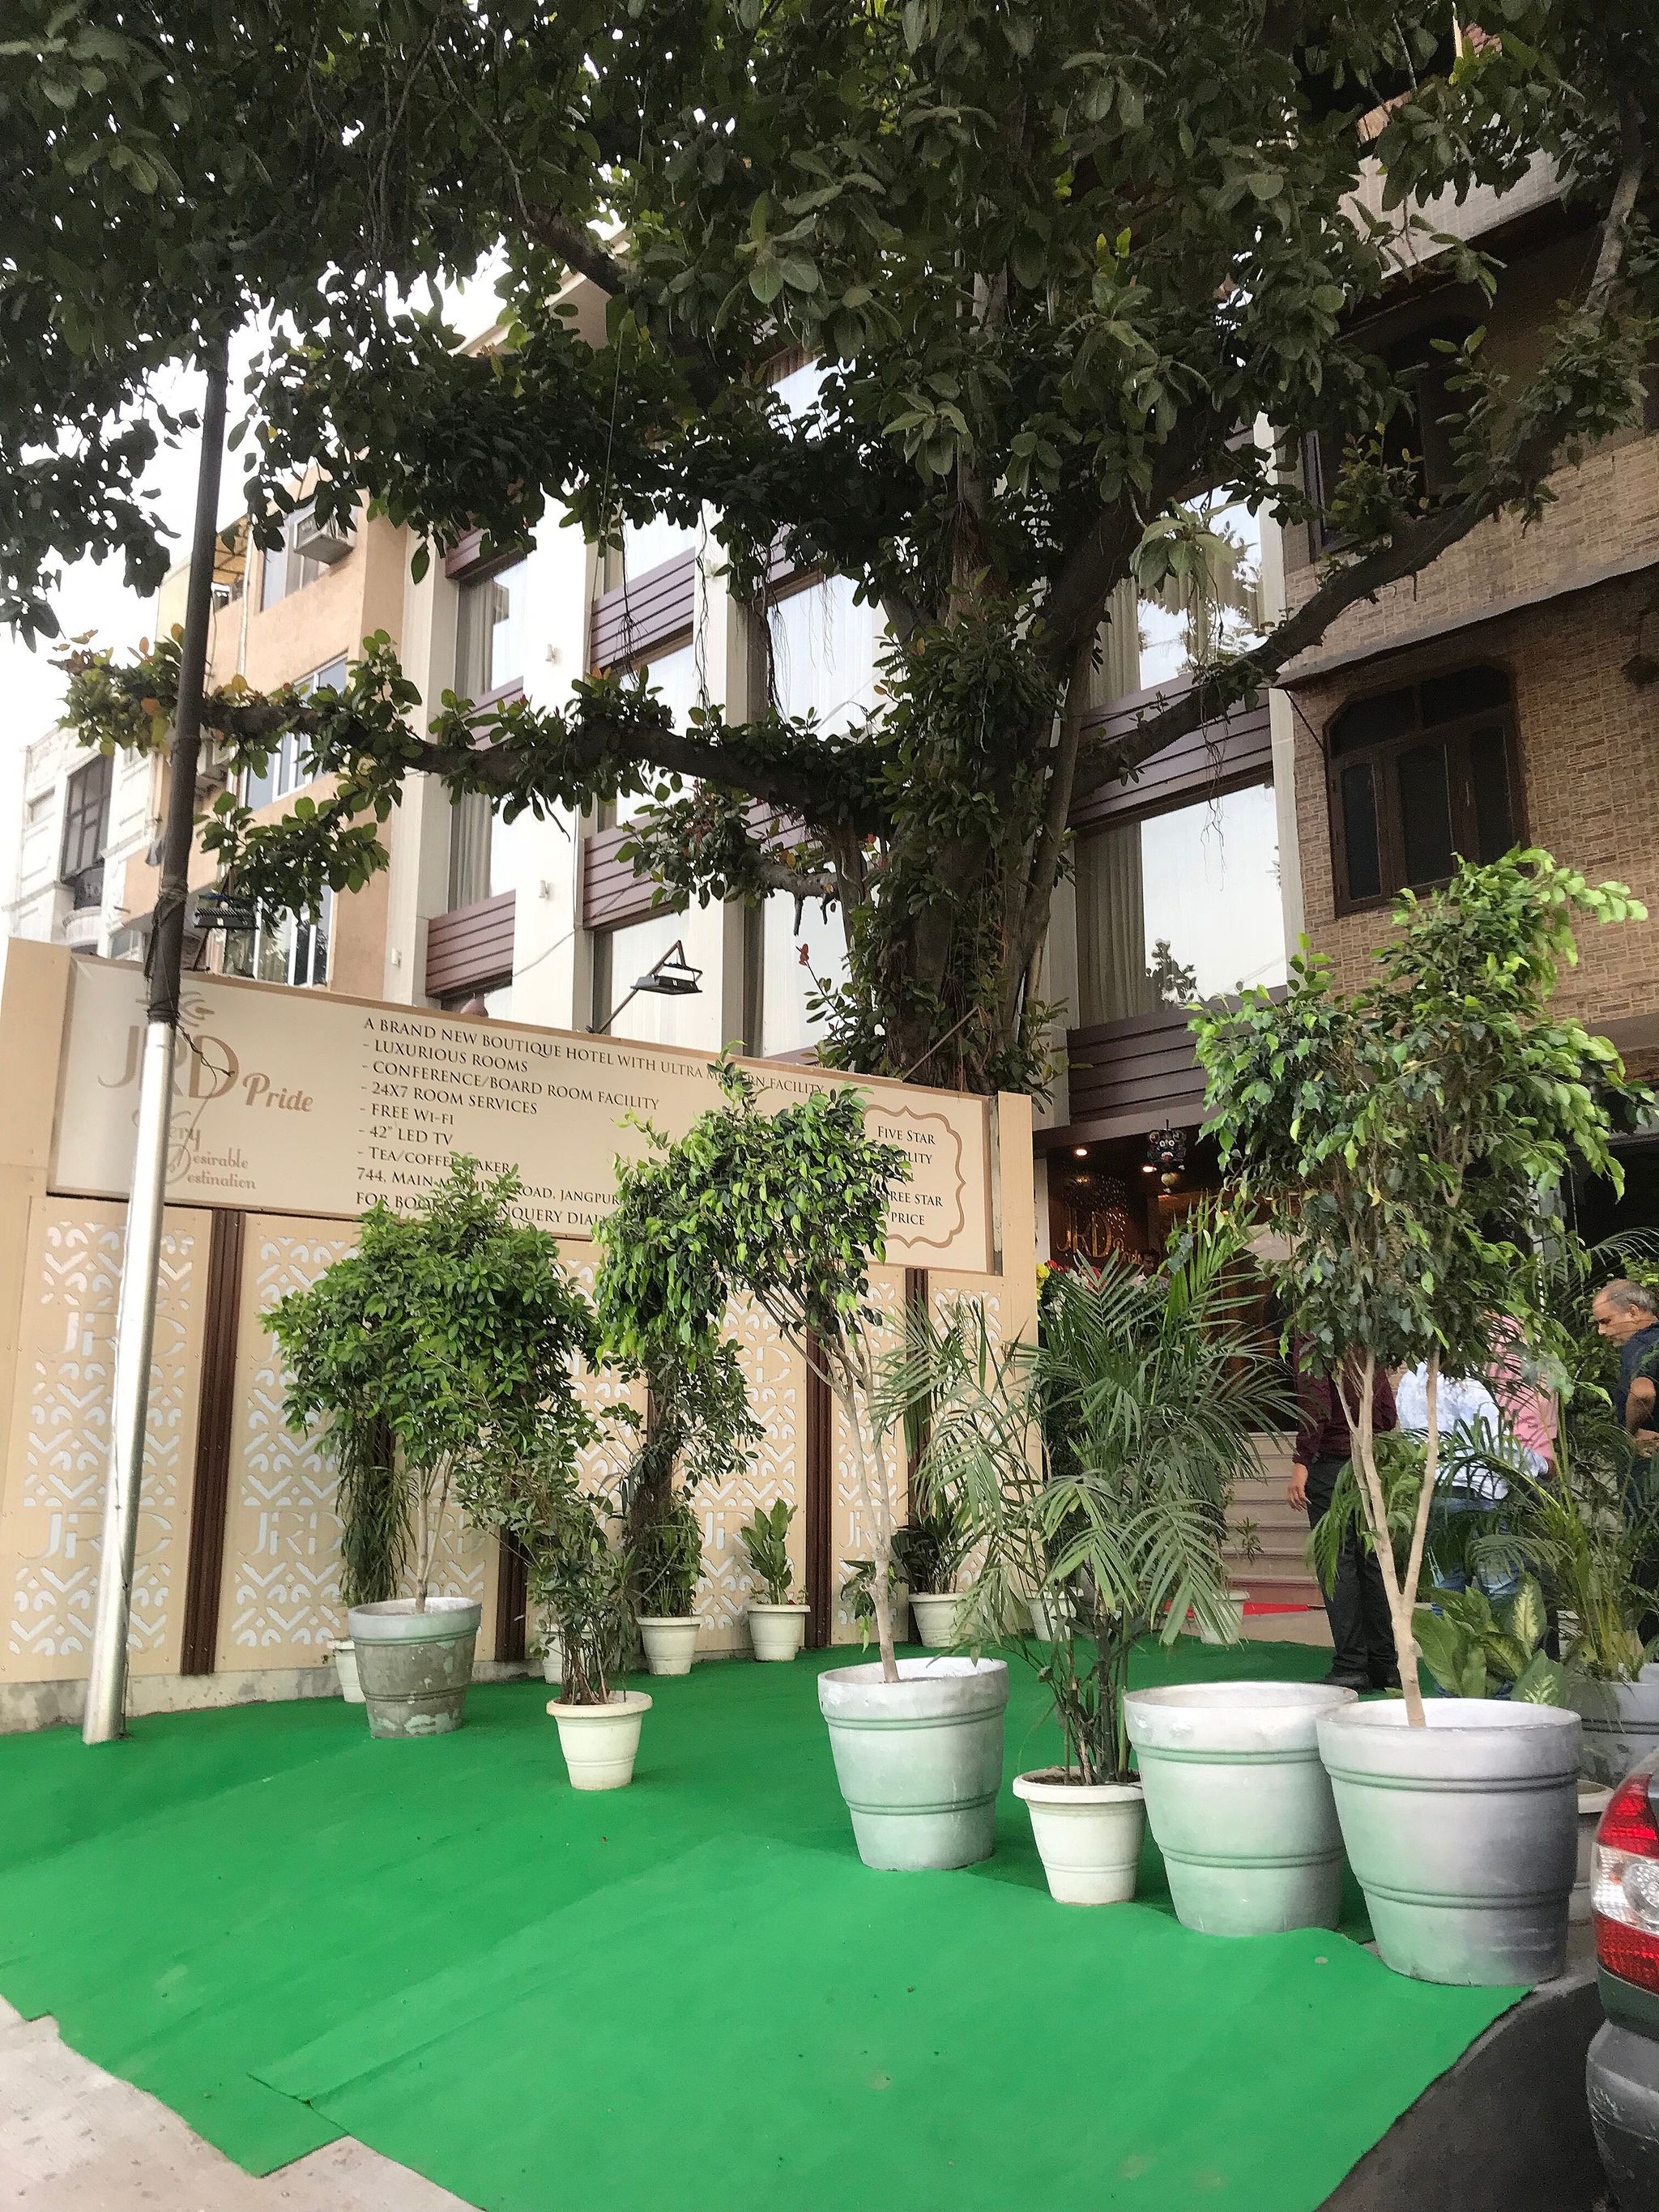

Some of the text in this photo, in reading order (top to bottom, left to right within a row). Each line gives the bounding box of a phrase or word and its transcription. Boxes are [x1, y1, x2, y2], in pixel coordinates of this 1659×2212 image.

[364, 1017, 824, 1094] A BRAND NEW BOUTIQUE HOTEL WITH ULTRA MRN FACILITY
[375, 1039, 467, 1064] LUXURIOUS
[472, 1054, 528, 1072] ROOMS
[243, 1072, 313, 1112] Pride
[373, 1061, 543, 1094] CONFERENCE/BOARD
[548, 1084, 593, 1102] ROOM
[598, 1091, 659, 1110] FACILITY
[371, 1103, 408, 1120] FREE
[414, 1087, 463, 1106] ROOM
[468, 1094, 537, 1115] SERVICES
[398, 1127, 428, 1143] LED
[433, 1132, 454, 1145] TV
[877, 1126, 936, 1144] FIVE STAR
[392, 1171, 433, 1187] MAIN
[516, 1185, 556, 1200] OAD,
[356, 1191, 389, 1207] FOR
[499, 1205, 562, 1224] NQUERY
[915, 1194, 943, 1207] STAR
[891, 1212, 925, 1225] PRICE
